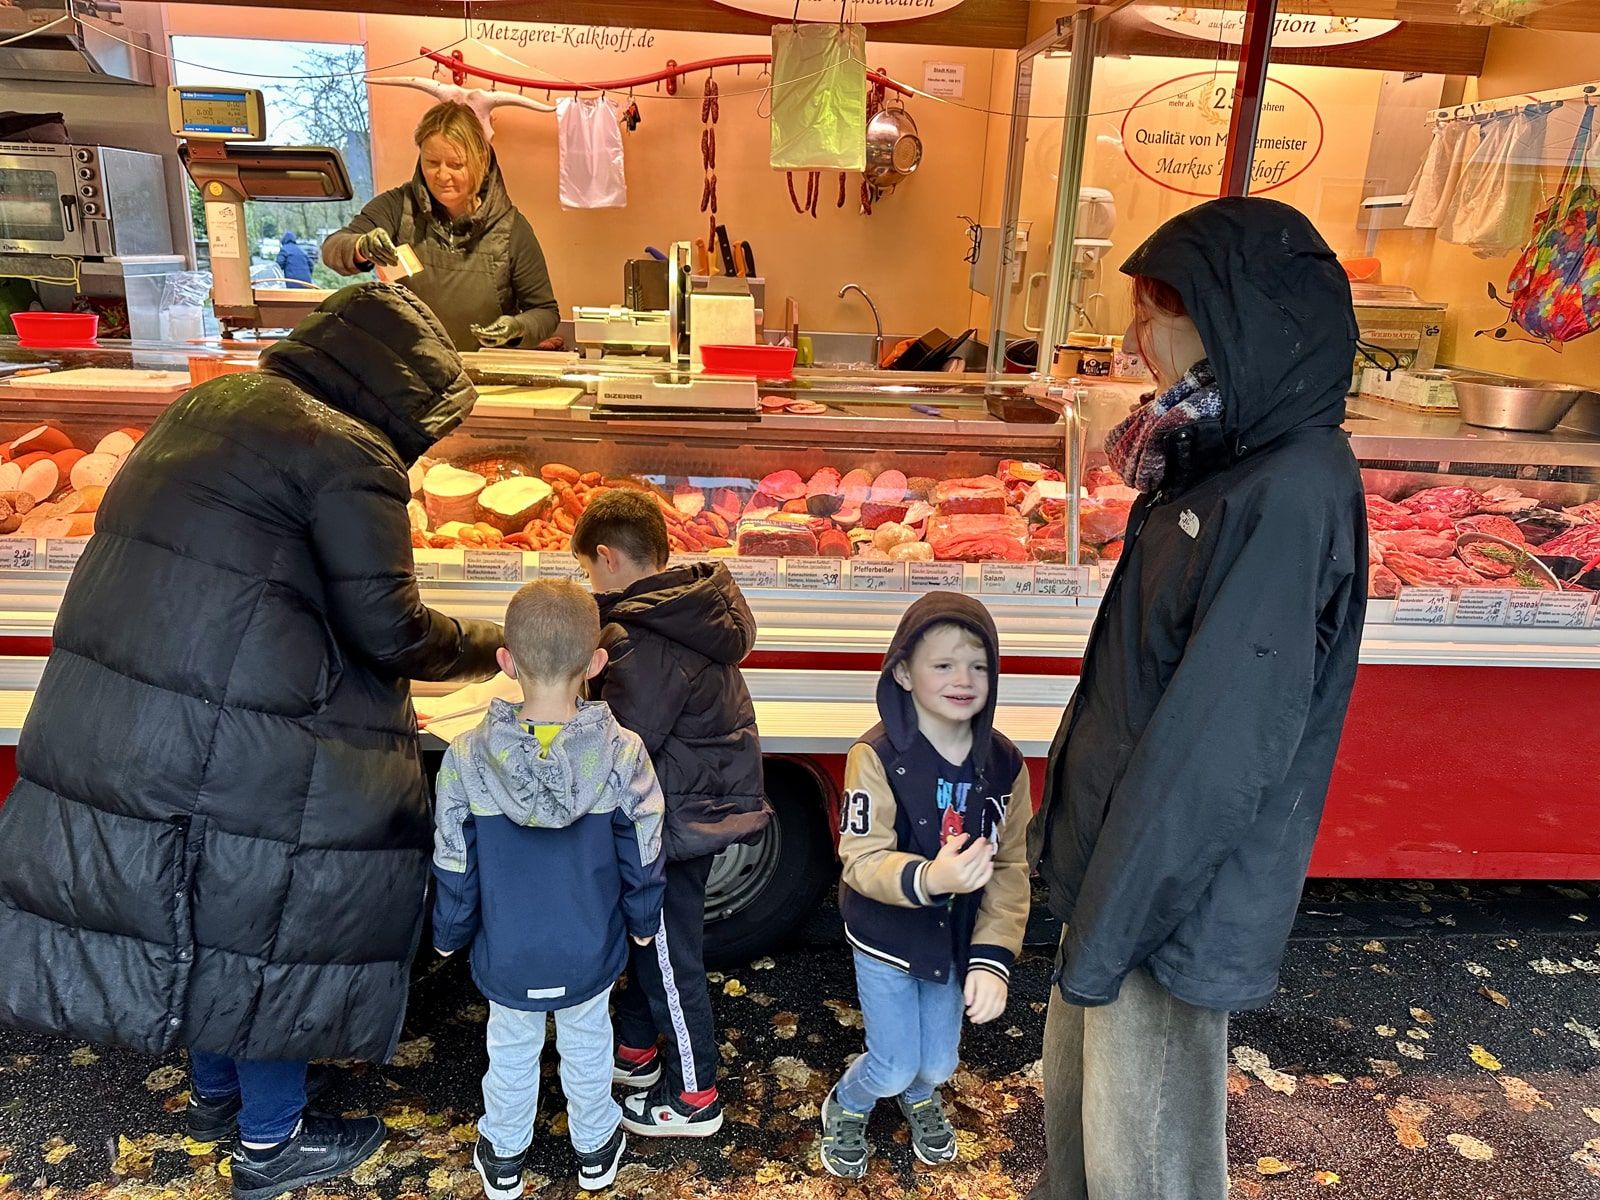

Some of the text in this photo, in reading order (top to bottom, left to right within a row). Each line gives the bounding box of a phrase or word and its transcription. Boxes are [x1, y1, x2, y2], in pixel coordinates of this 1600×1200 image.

[477, 22, 655, 53] Metzgerei-Kalkhoff.de
[1168, 99, 1194, 108] mehr als
[1260, 101, 1285, 113] ahren
[1135, 129, 1184, 146] Qualität
[1189, 135, 1210, 146] von
[1155, 157, 1213, 179] Markus
[853, 566, 895, 574] Pfefferbeißer
[1036, 577, 1079, 585] Mettwürstchen
